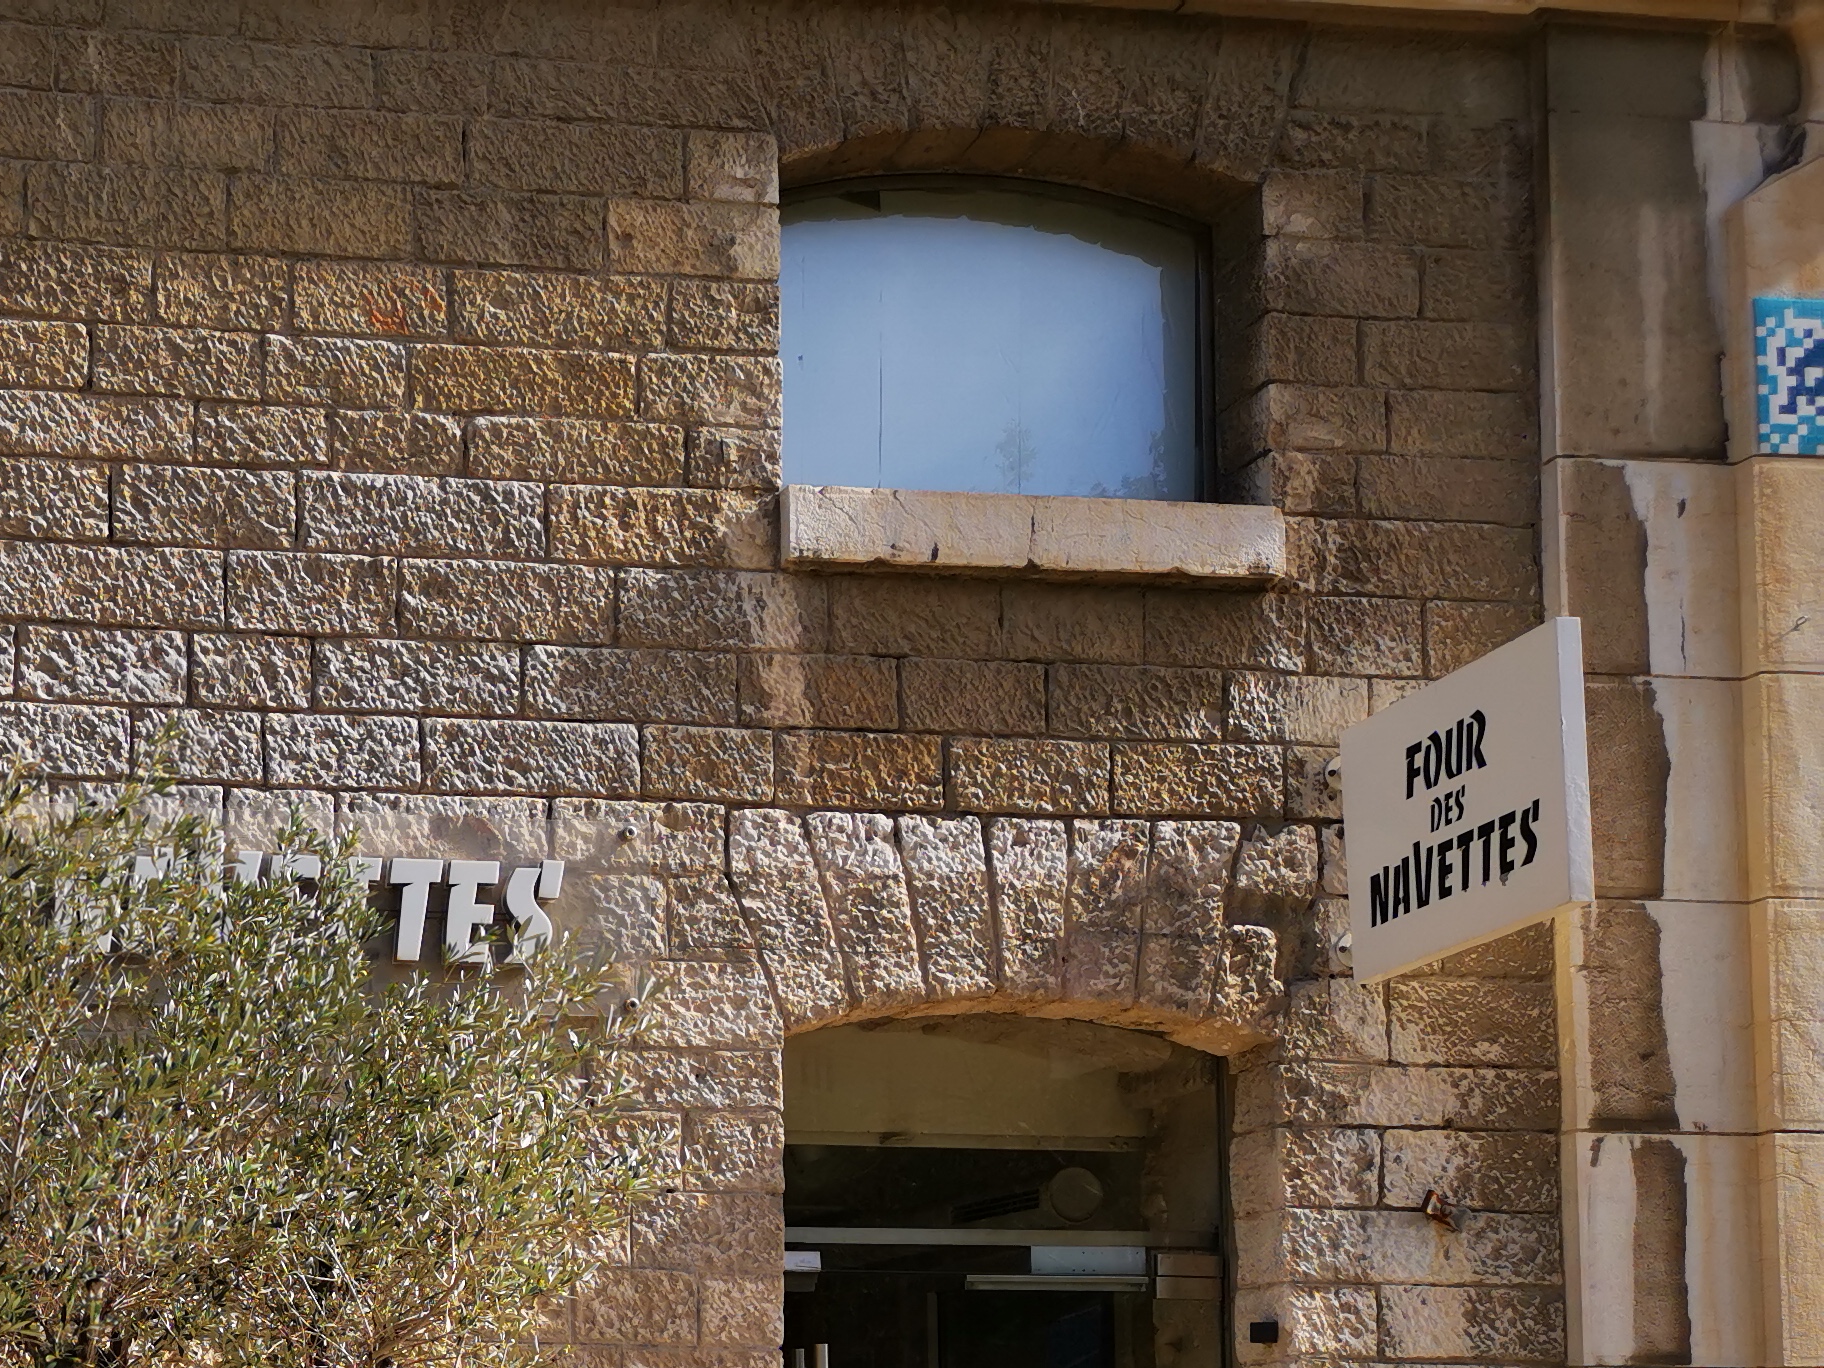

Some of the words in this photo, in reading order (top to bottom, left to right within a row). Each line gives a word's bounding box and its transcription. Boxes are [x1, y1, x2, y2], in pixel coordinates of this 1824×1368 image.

[1405, 709, 1487, 800] FOUR
[1430, 784, 1466, 833] DES
[1370, 798, 1540, 928] NAVETTES
